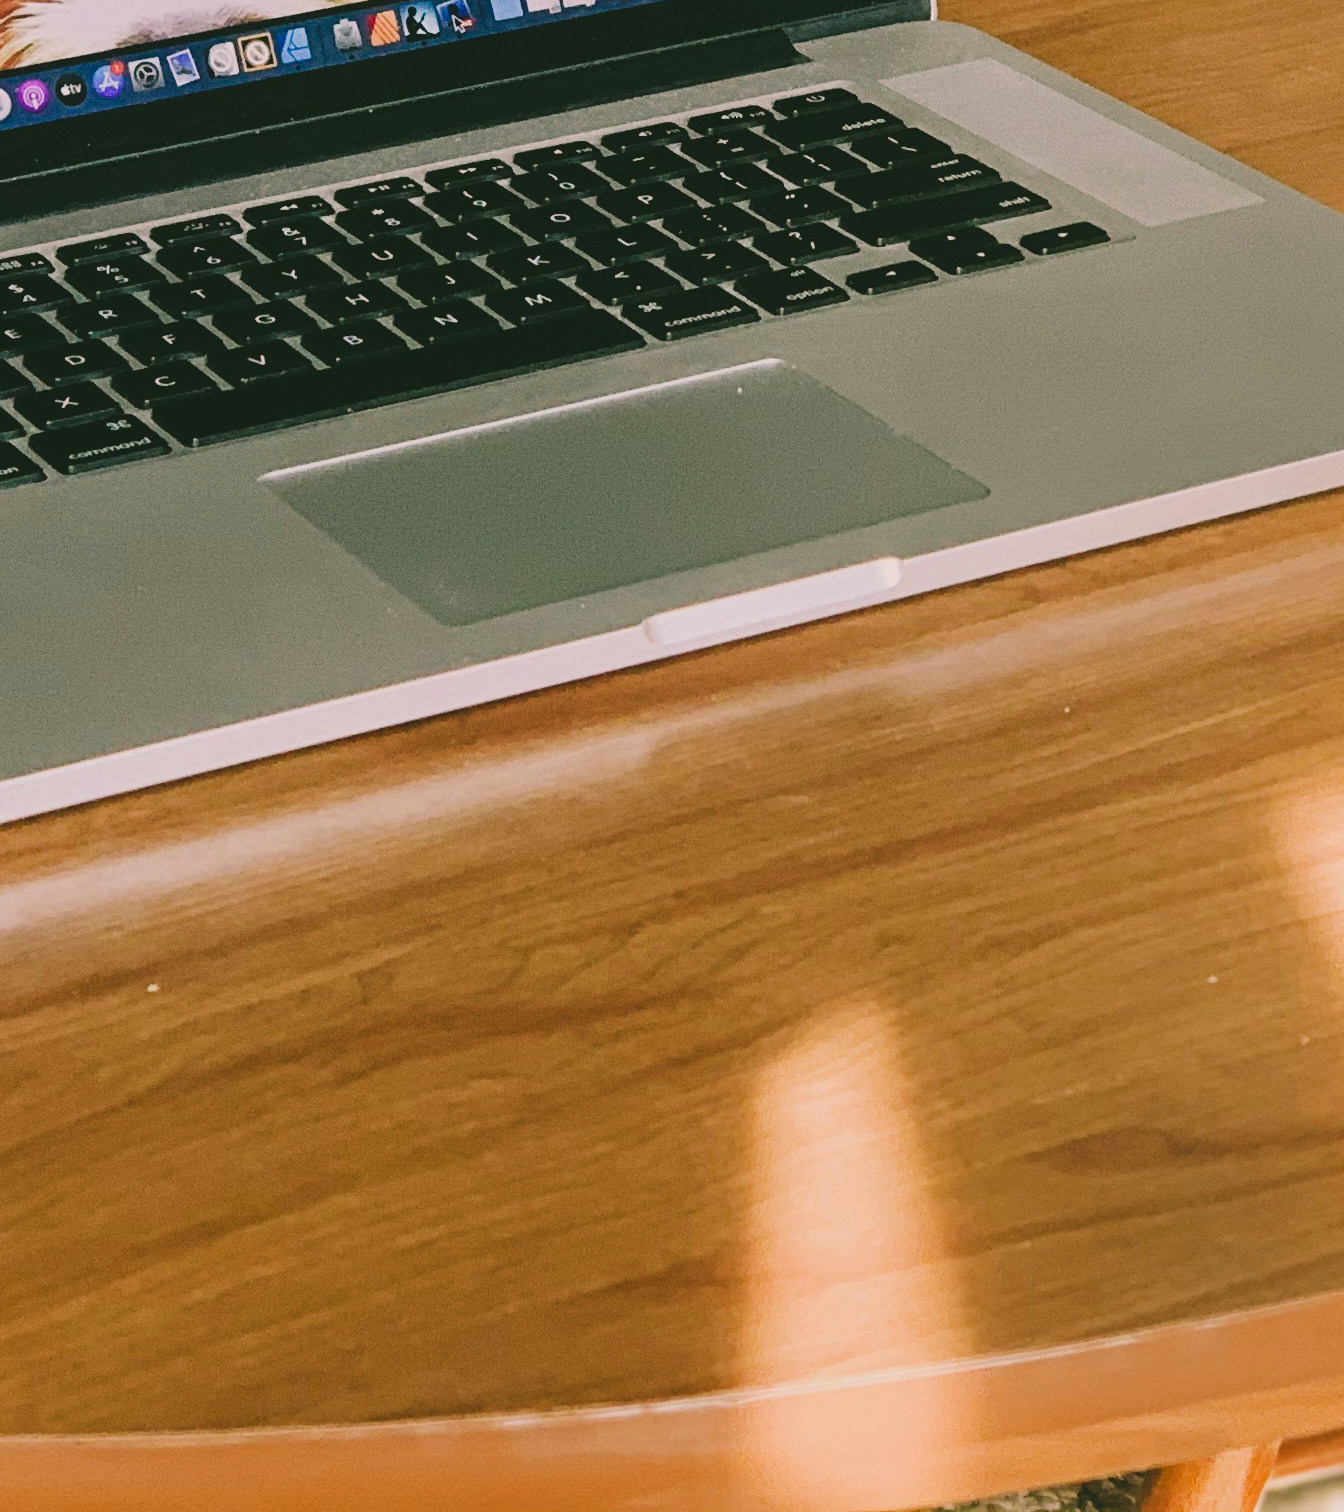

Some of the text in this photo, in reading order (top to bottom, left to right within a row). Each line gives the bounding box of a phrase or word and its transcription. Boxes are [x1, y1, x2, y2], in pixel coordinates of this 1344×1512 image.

[344, 293, 370, 306] H
[524, 293, 553, 307] M
[98, 308, 119, 320] R
[254, 314, 276, 325] G
[433, 313, 459, 326] N
[4, 328, 22, 340] E
[343, 335, 364, 346] B
[64, 354, 86, 366] D
[247, 354, 266, 366] V
[154, 376, 176, 387] C
[55, 396, 79, 409] X
[68, 437, 152, 460] command
